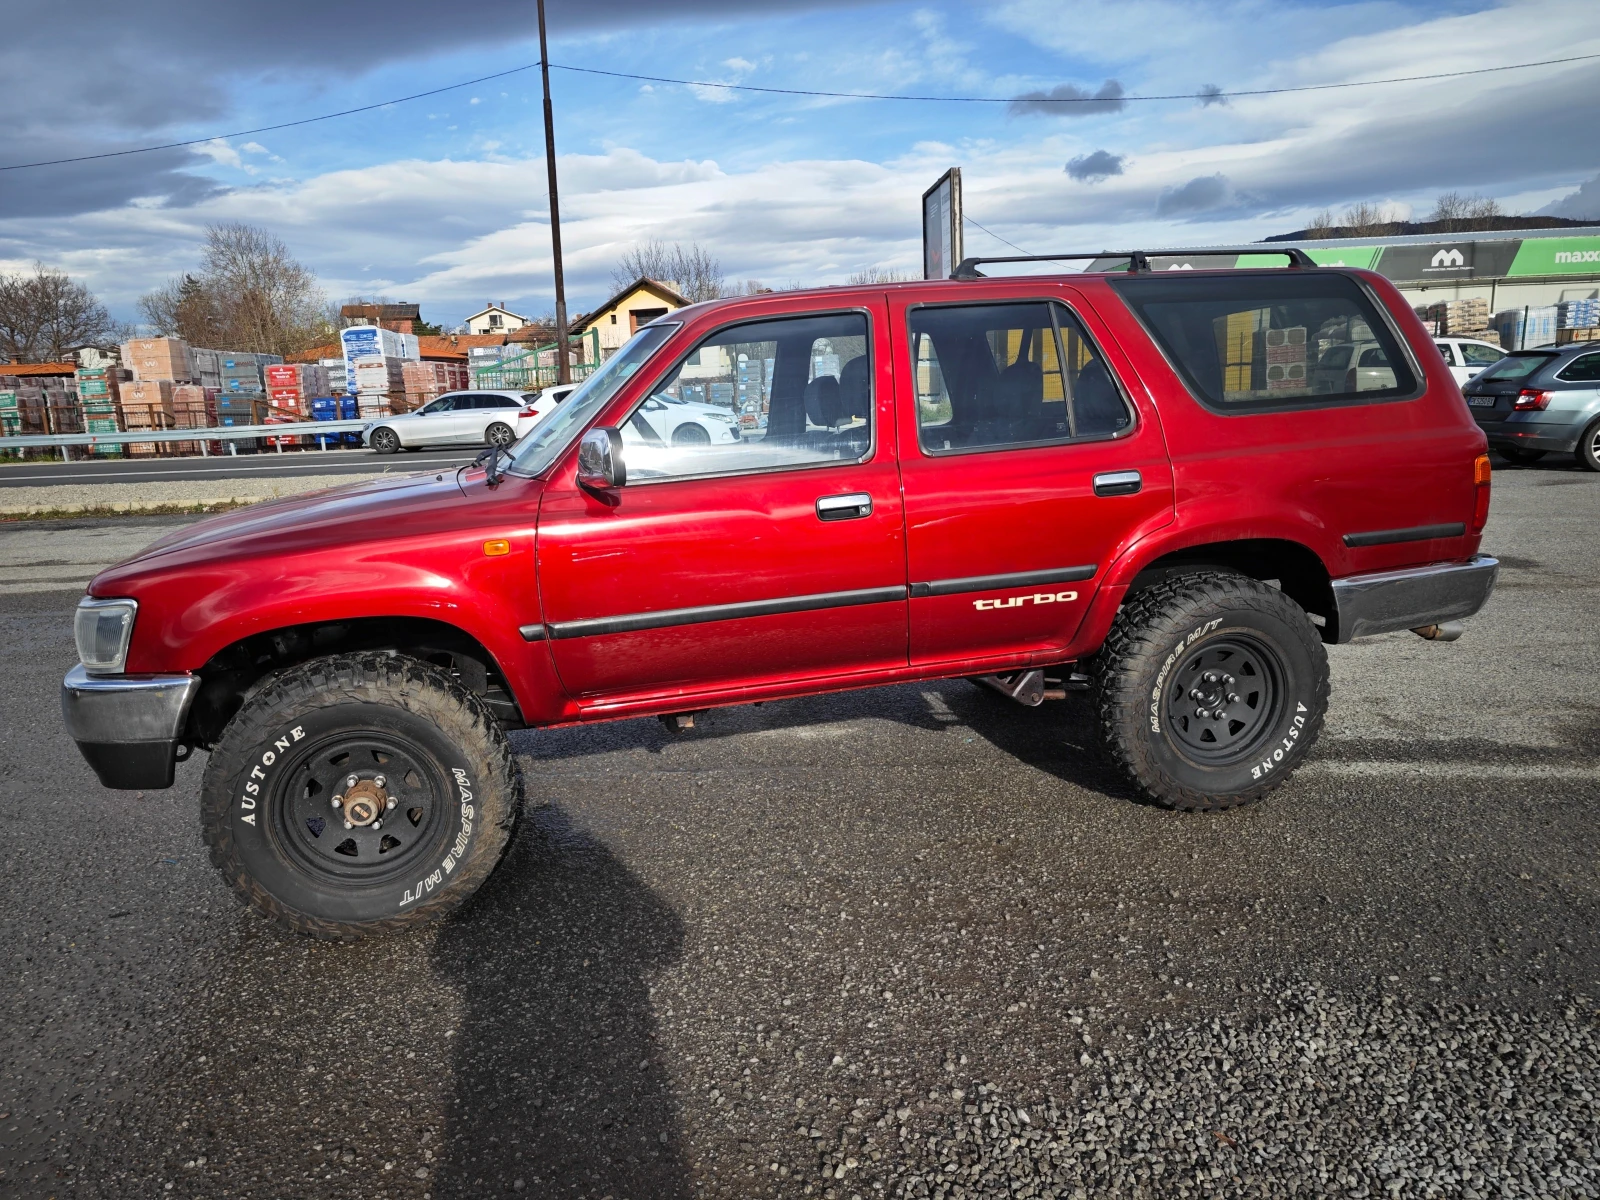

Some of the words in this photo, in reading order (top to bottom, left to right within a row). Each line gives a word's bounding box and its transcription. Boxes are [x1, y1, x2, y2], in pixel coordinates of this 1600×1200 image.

[972, 590, 1079, 611] turbo
[1150, 640, 1185, 733] MASPIRE
[1187, 617, 1224, 646] M/T
[240, 725, 307, 827] AUSTONE
[1251, 701, 1308, 780] AUSTONE
[441, 767, 473, 875] MASPIRE
[399, 871, 443, 907] M/T
